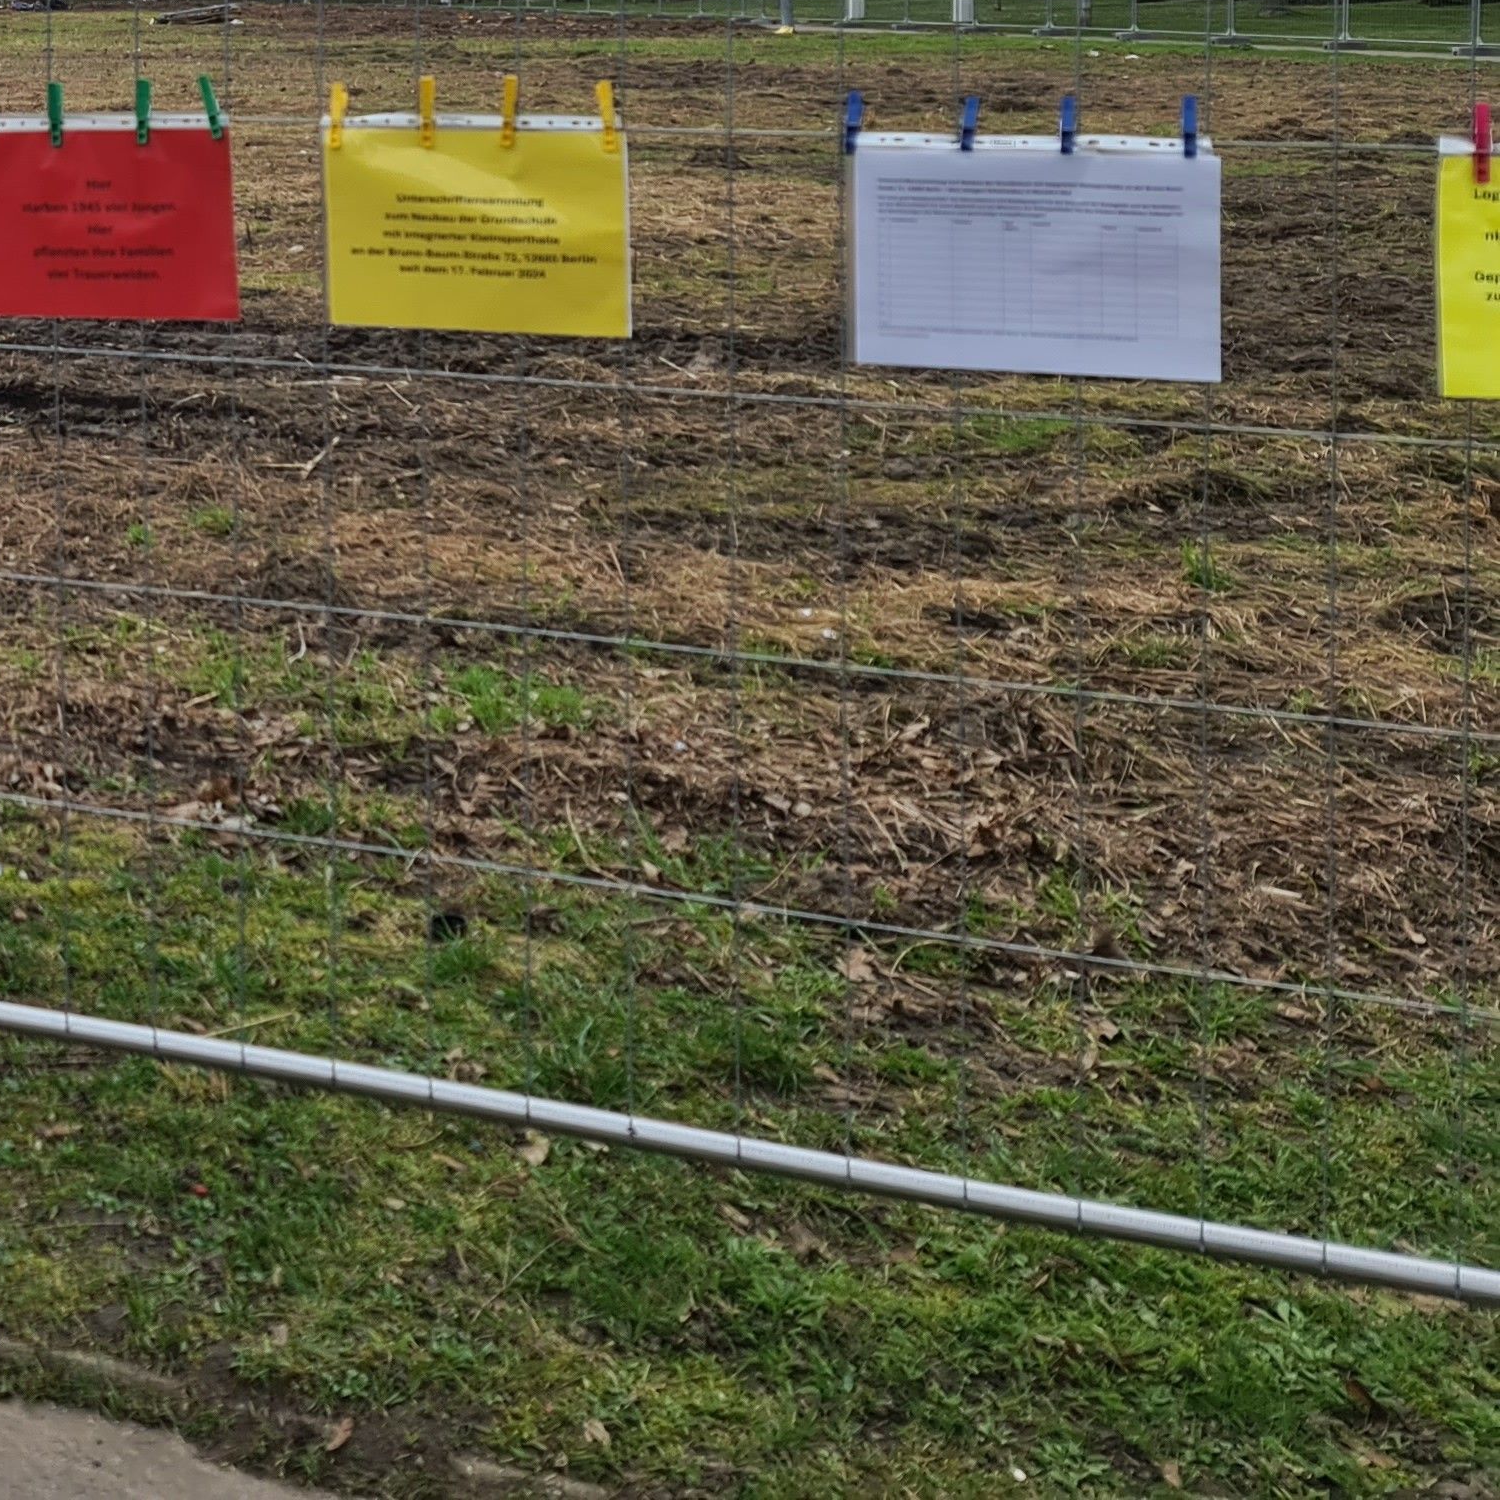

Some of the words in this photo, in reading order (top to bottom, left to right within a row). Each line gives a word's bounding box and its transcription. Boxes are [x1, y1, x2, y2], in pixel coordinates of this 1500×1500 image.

[383, 213, 408, 222] zum
[458, 213, 478, 224] der
[350, 247, 365, 256] an
[367, 246, 385, 256] der
[562, 254, 598, 265] Berlin
[422, 264, 448, 274] dem
